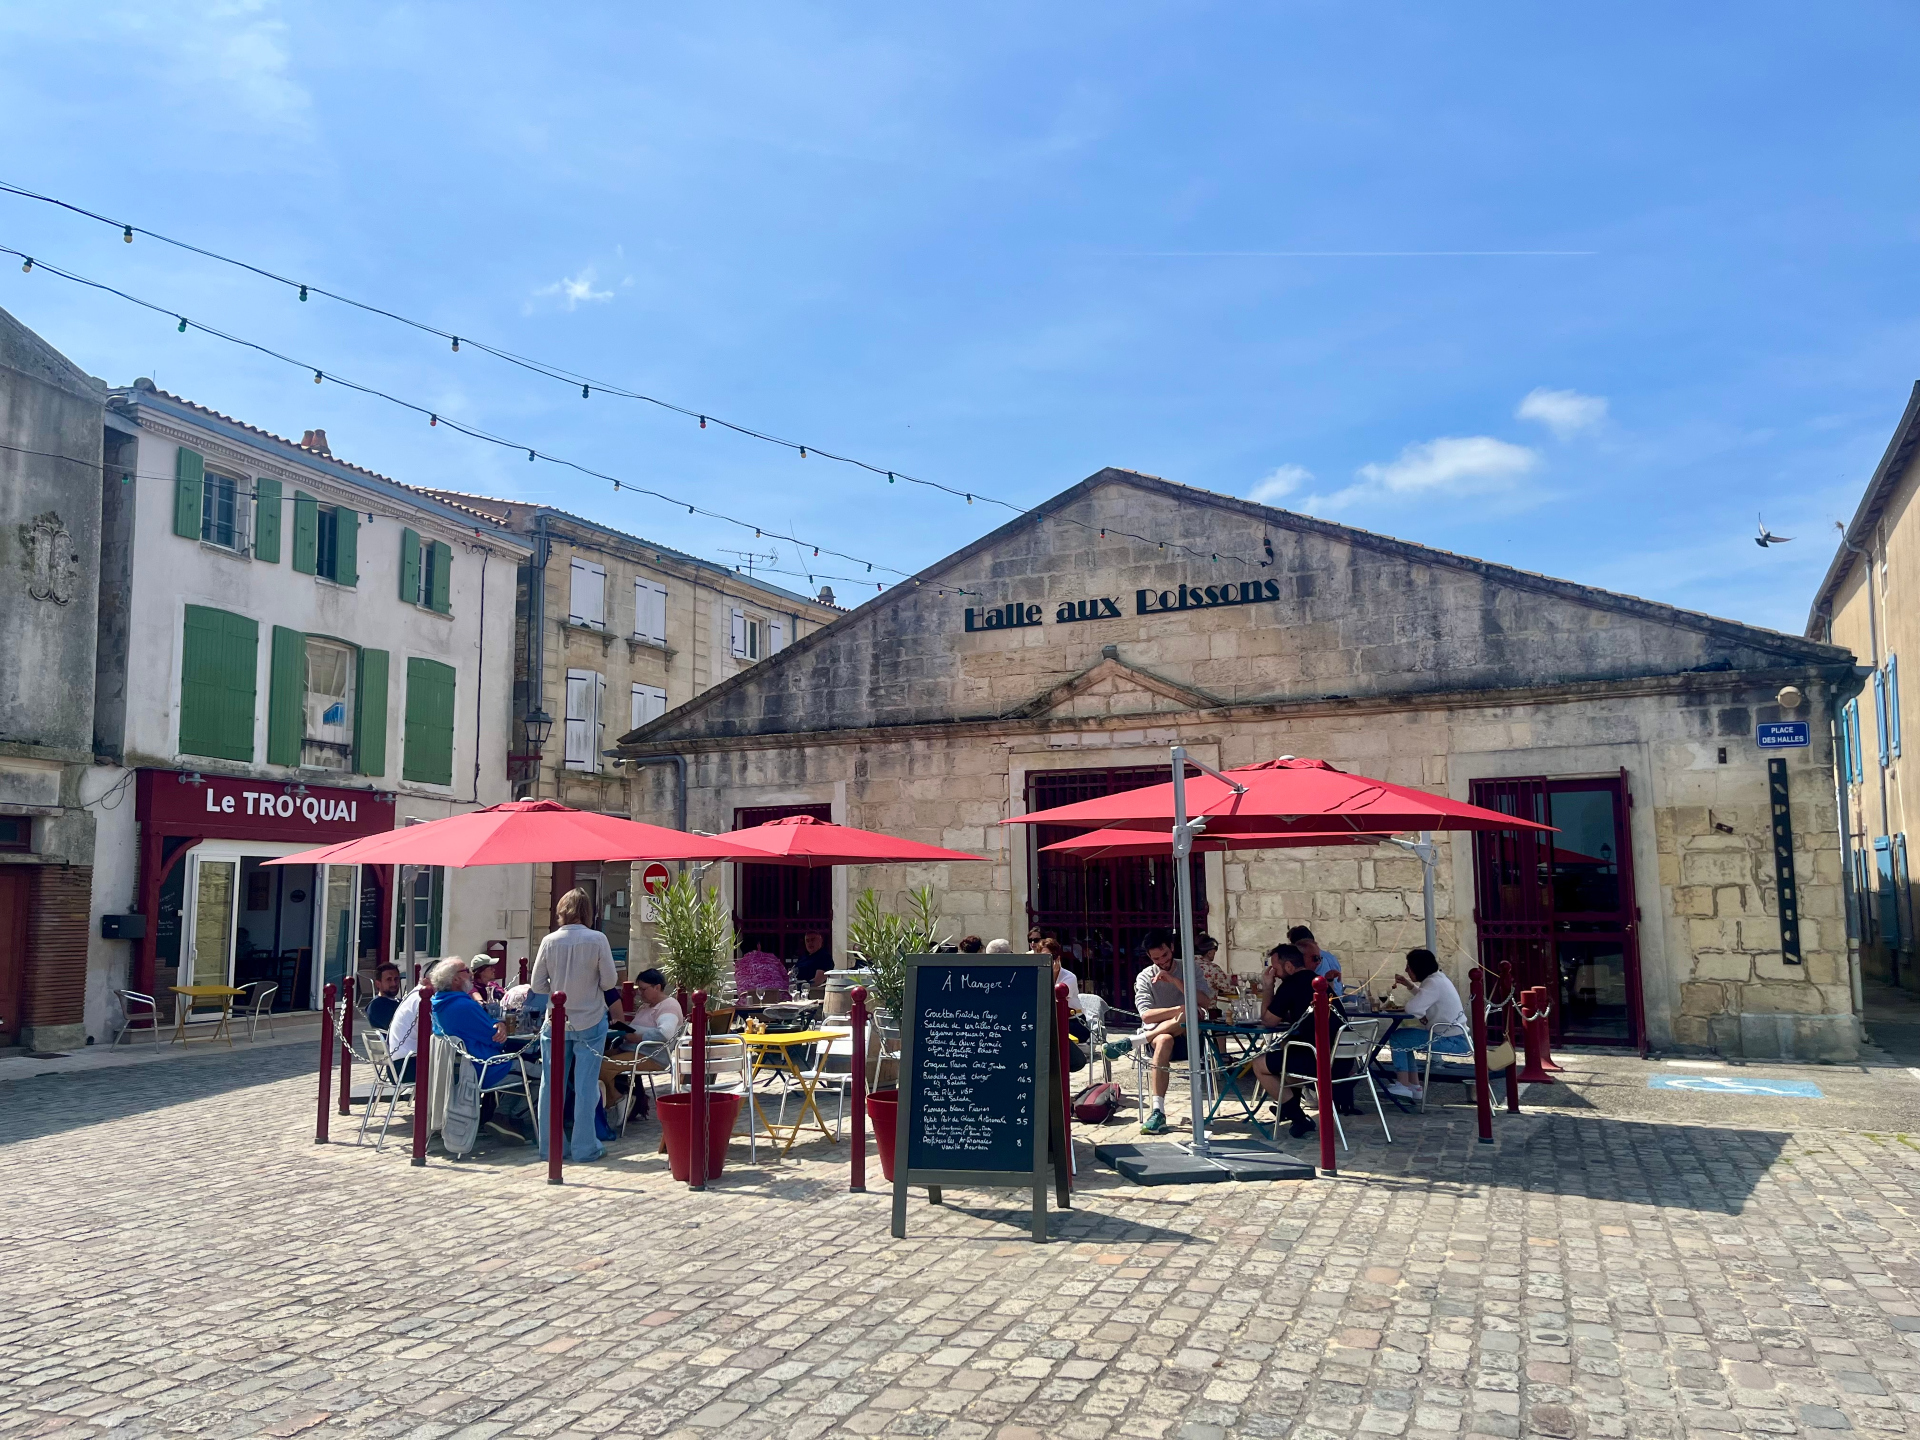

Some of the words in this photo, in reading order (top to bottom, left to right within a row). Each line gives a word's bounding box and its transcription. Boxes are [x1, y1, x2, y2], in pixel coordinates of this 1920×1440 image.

[964, 602, 1042, 633] Halle
[1056, 597, 1122, 623] aux
[1136, 578, 1280, 615] Poissons
[206, 788, 235, 813] Le
[243, 791, 357, 824] TRO'QUAI
[941, 970, 952, 992] À
[961, 974, 1002, 994] Manger
[1007, 972, 1016, 988] !
[924, 1020, 949, 1028] Salade
[923, 1059, 948, 1072] Croque
[1019, 1062, 1029, 1070] 13
